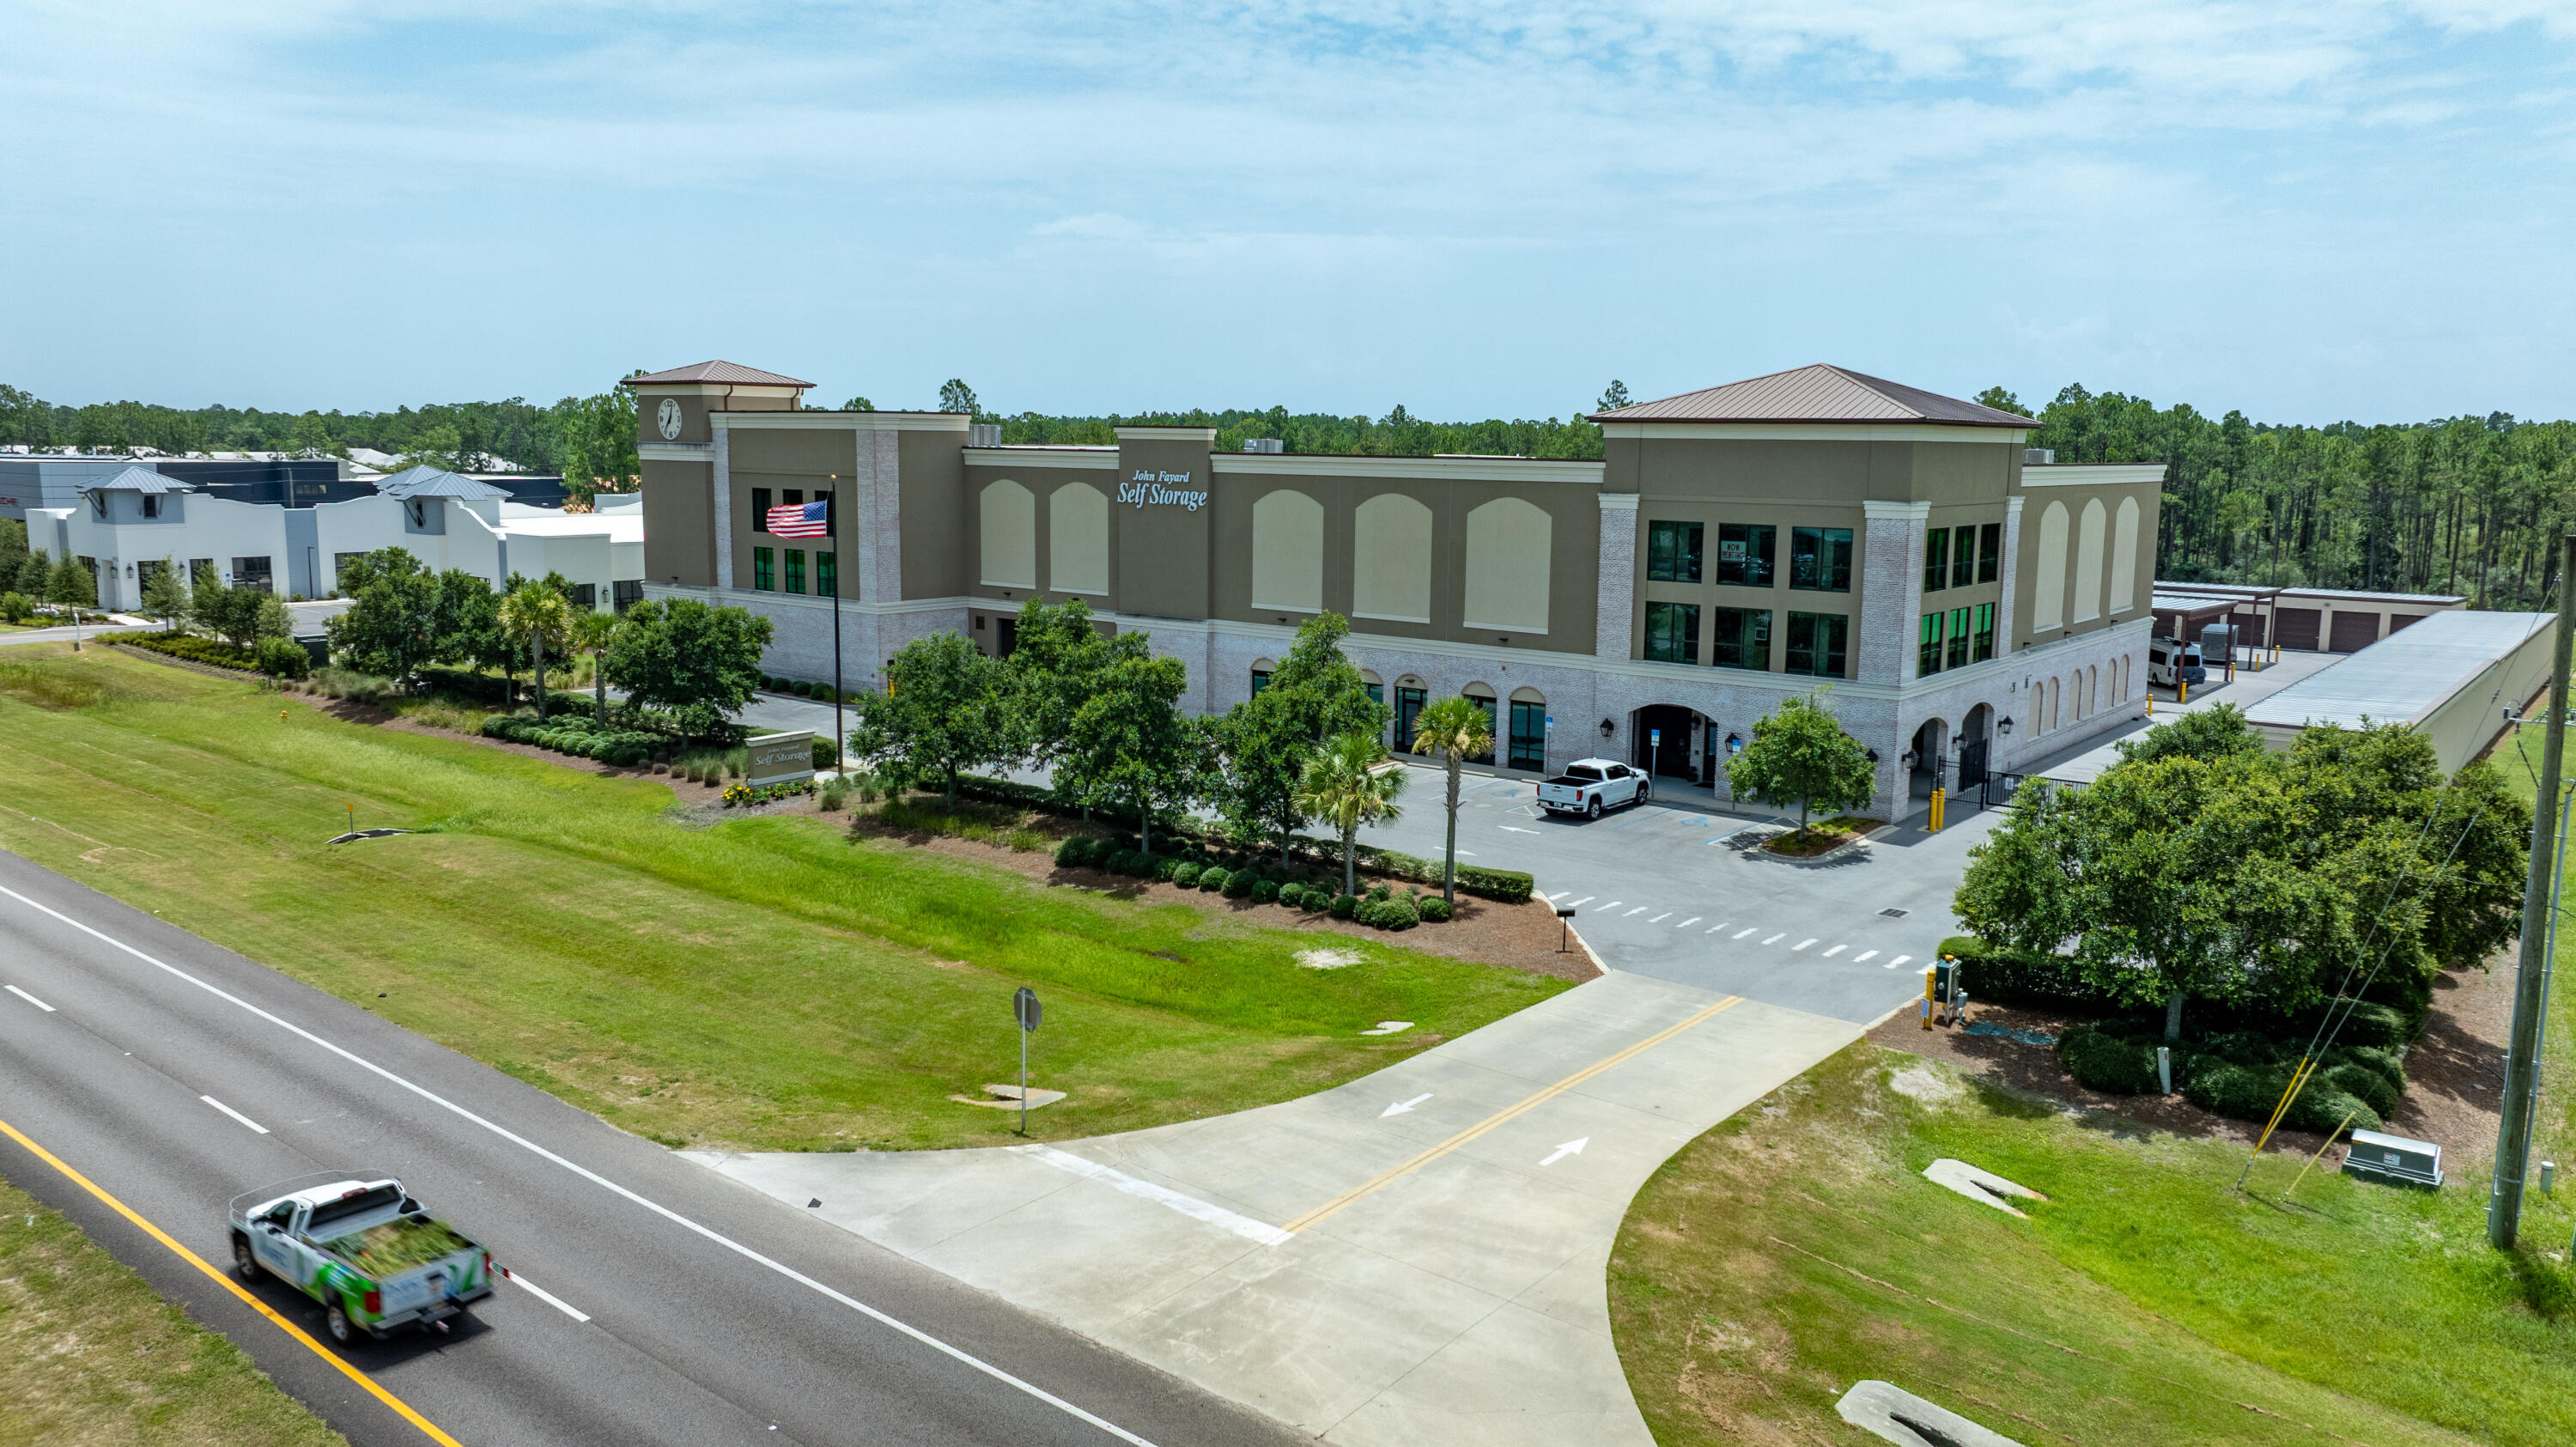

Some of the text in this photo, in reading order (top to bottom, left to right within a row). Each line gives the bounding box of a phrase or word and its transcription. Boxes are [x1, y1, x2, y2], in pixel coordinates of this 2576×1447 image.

[1133, 470, 1190, 484] John Fayard
[1117, 483, 1208, 512] Self Storage
[755, 751, 811, 767] Self Storage
